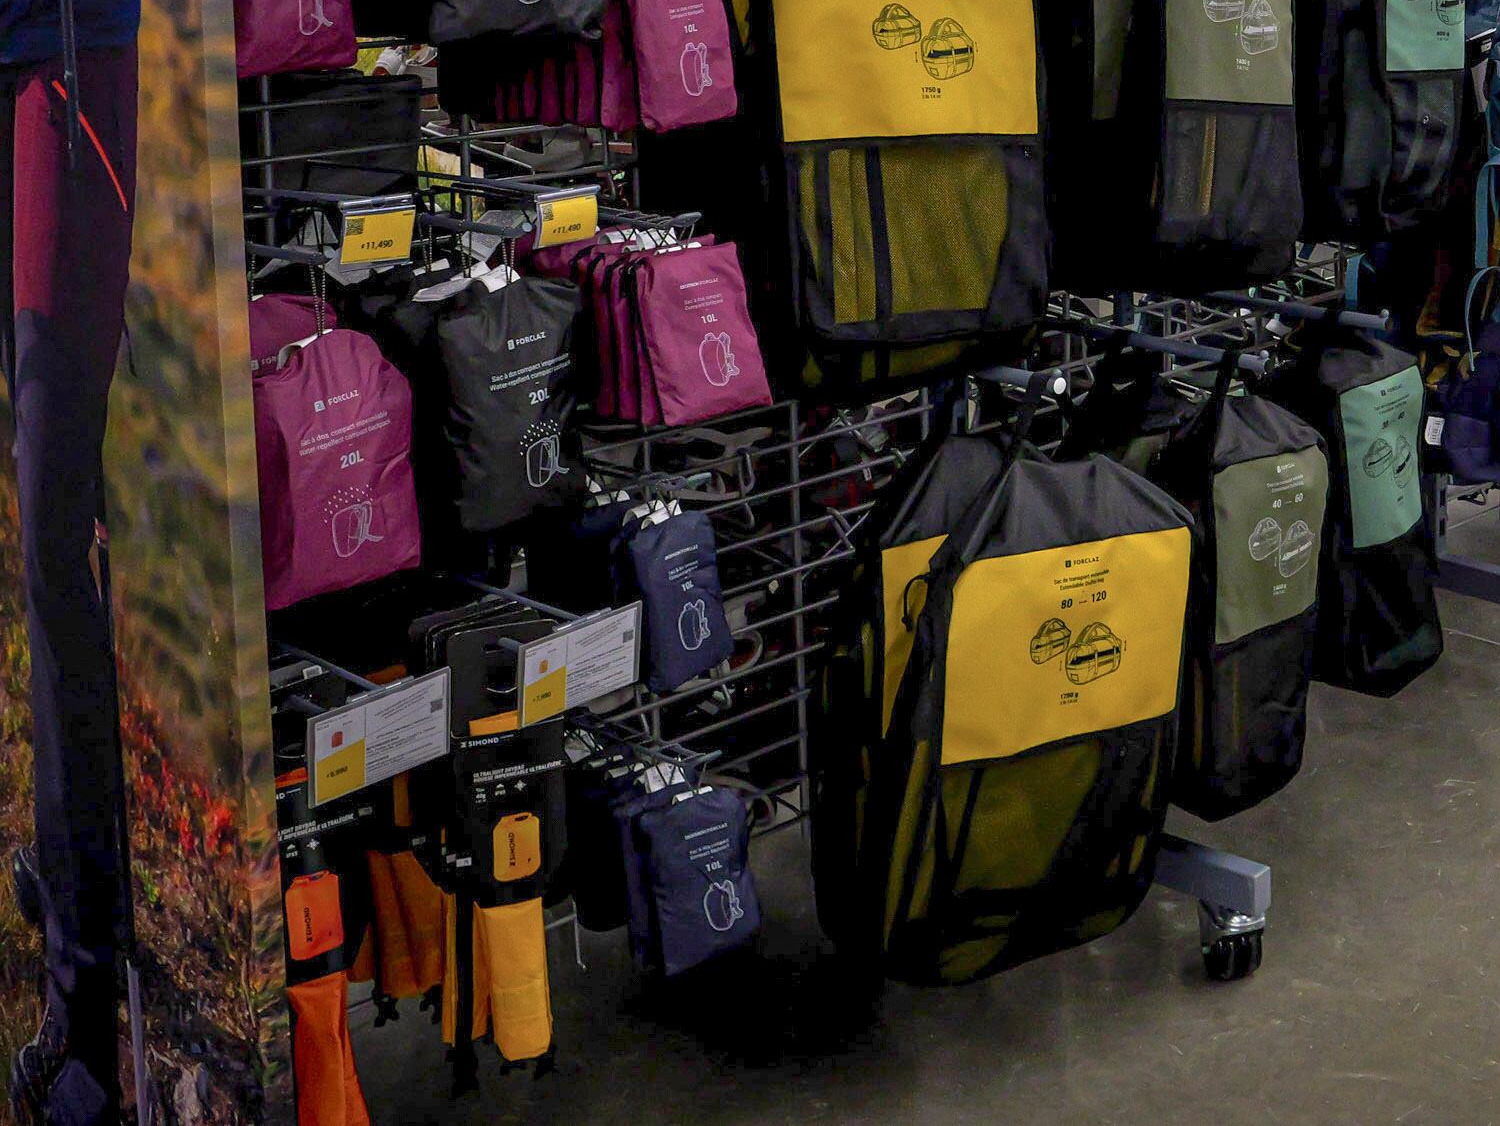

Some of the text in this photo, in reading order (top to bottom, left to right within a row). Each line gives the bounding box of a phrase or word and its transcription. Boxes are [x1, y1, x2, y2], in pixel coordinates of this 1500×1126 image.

[684, 23, 698, 33] 10L
[701, 313, 718, 324] 10L
[515, 331, 547, 346] FORCLAZ
[491, 375, 504, 383] Sac
[327, 389, 359, 406] FORCLAZ
[528, 387, 550, 405] 20L
[317, 433, 330, 442] dos
[330, 423, 355, 437] compact
[340, 450, 364, 469] 20L
[1272, 498, 1282, 508] 40
[1061, 590, 1107, 609] 80 120
[468, 737, 499, 747] SIMOND
[705, 860, 723, 872] 10L
